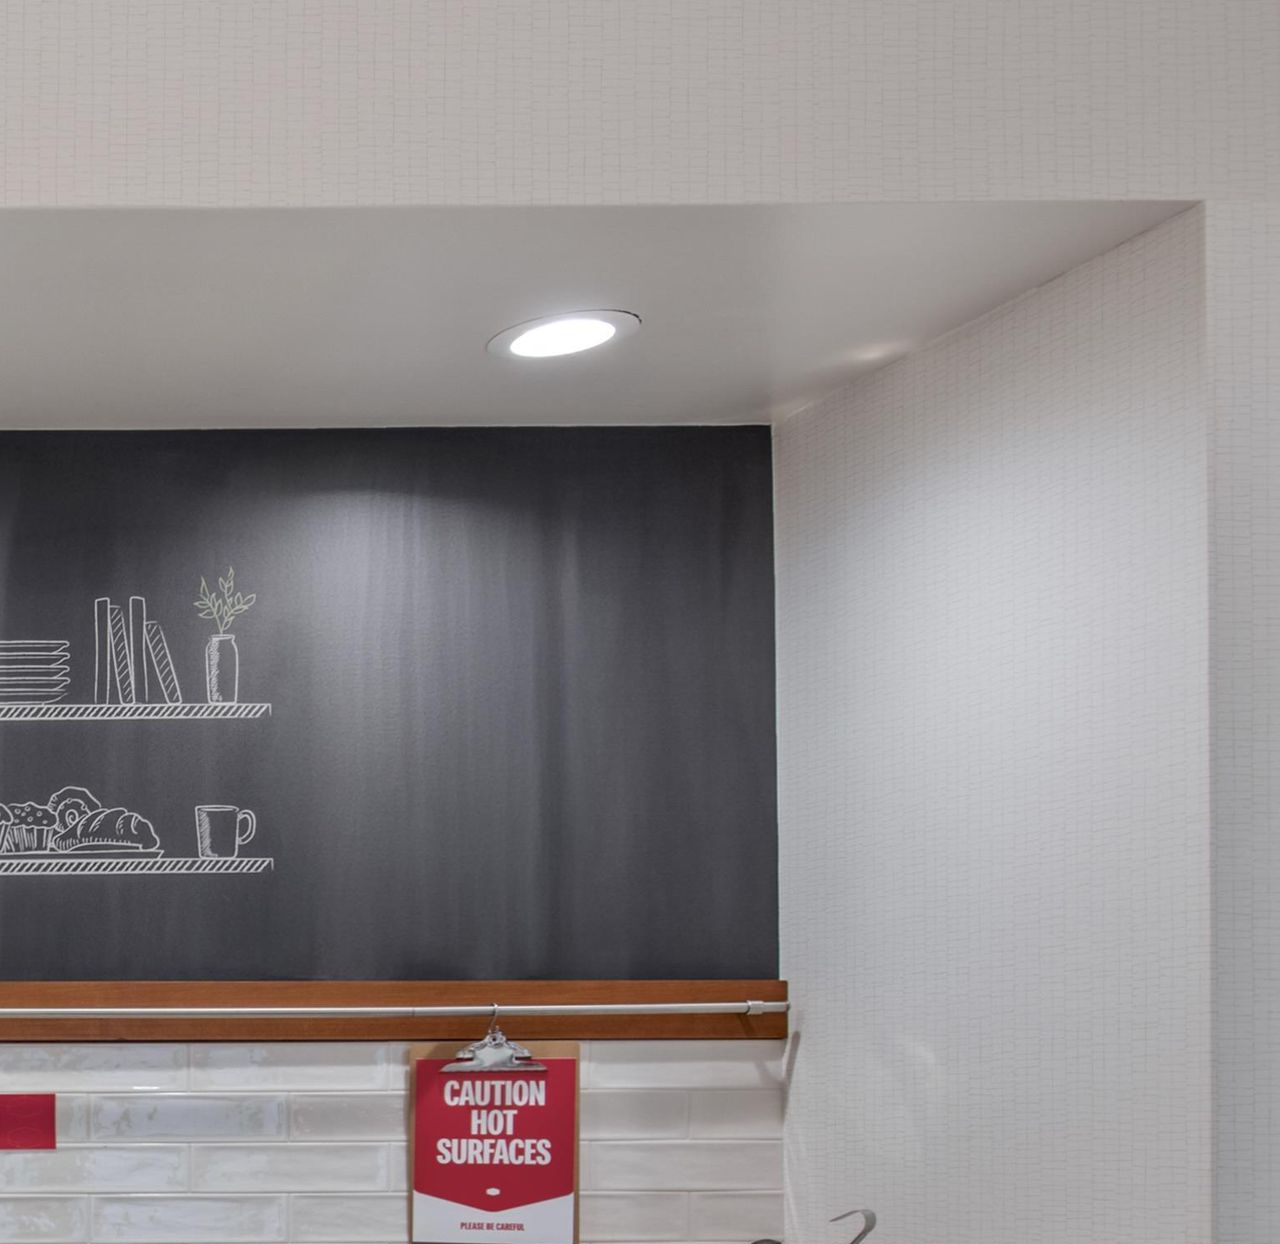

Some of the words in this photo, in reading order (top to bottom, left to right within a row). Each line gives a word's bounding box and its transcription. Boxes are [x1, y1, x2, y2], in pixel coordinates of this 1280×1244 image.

[444, 1080, 546, 1106] CAUTION
[470, 1110, 517, 1135] HOT
[436, 1139, 551, 1165] SURFACES
[460, 1222, 484, 1230] PLEASE
[486, 1222, 494, 1231] BE
[496, 1222, 524, 1231] CAREFUL
